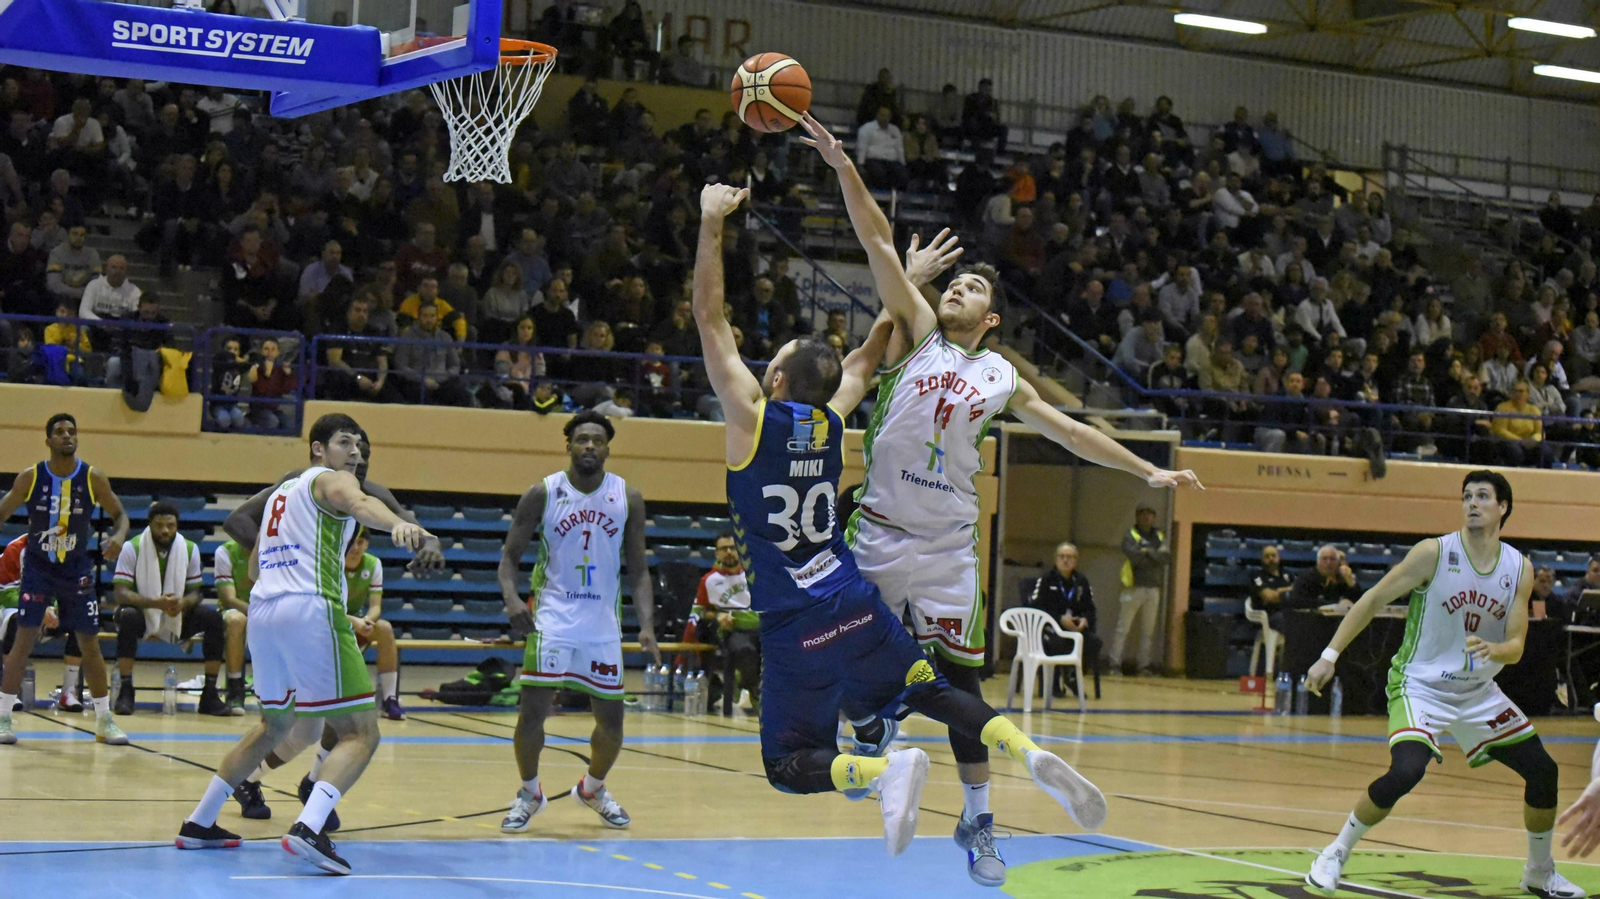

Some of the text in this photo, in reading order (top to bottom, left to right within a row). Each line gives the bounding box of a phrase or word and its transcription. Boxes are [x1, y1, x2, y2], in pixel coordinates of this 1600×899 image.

[112, 20, 315, 57] SPORT SYSTEM
[934, 397, 955, 430] 14
[789, 459, 824, 477] MIKI
[49, 495, 71, 515] 32
[266, 494, 287, 537] 8
[761, 481, 836, 552] 30
[554, 509, 619, 538] ZORNOTZA
[582, 530, 591, 550] 7
[795, 554, 837, 582] ercure
[566, 591, 601, 600] Trieneken
[1442, 590, 1506, 621] ZORNOTZA
[803, 613, 873, 648] master house
[1464, 611, 1482, 633] 10
